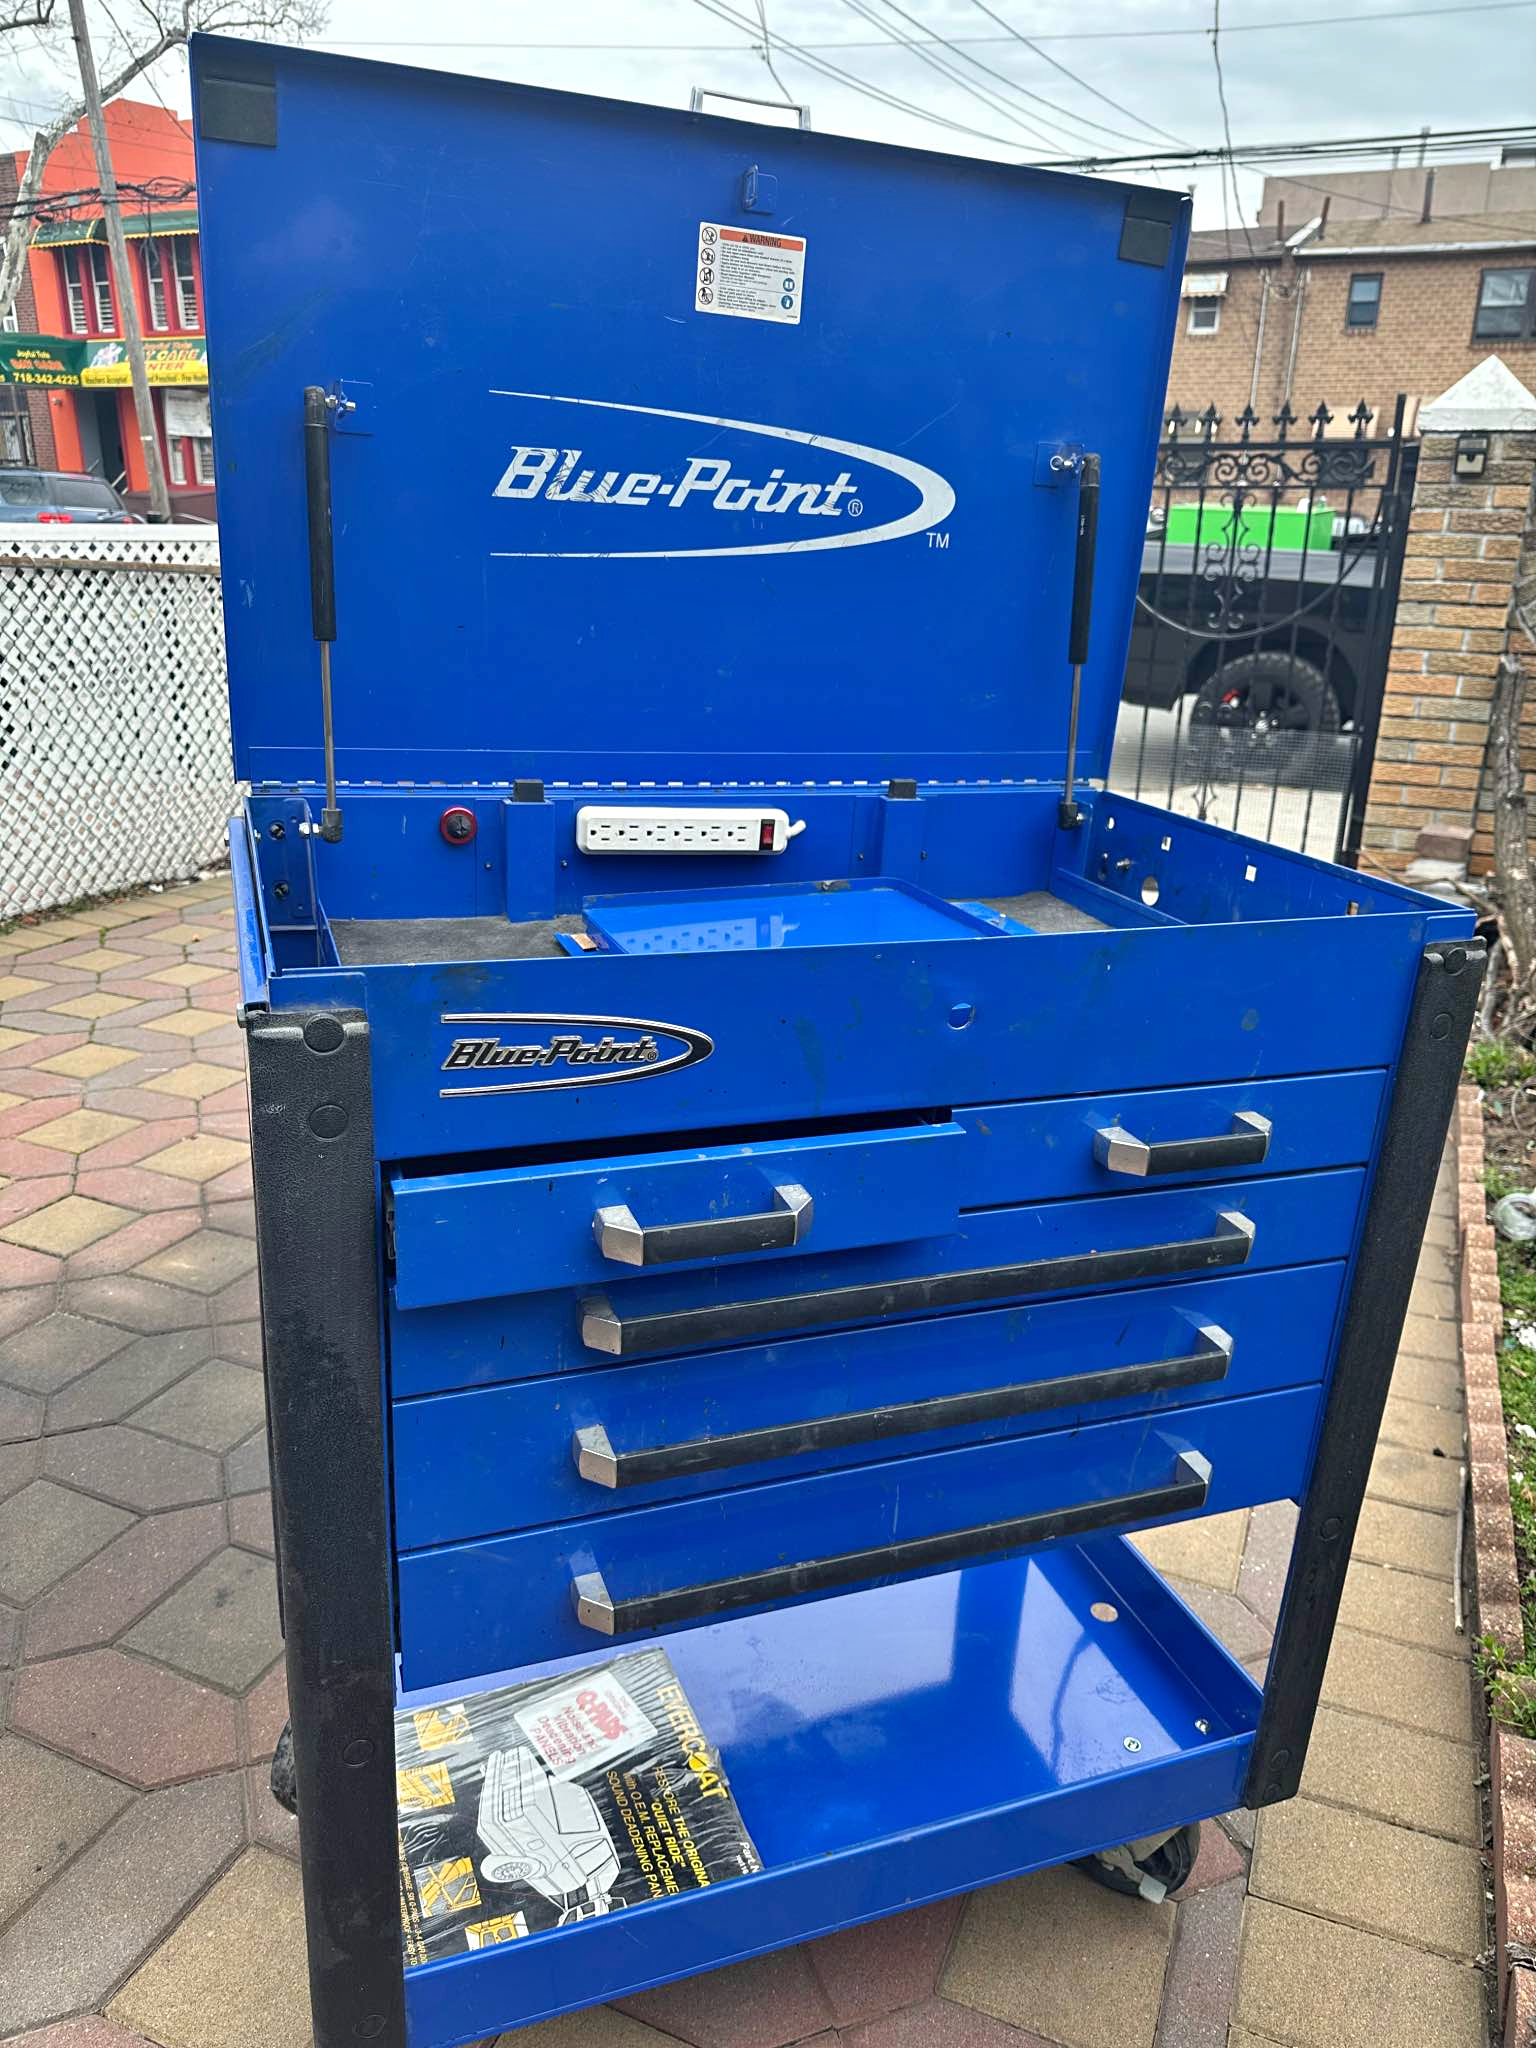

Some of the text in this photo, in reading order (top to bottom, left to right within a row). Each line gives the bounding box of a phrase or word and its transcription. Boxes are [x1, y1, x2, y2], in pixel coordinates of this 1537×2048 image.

[749, 233, 782, 248] WARNING
[926, 532, 950, 549] TM
[530, 1727, 561, 1766] PANELS
[656, 1685, 728, 1800] EVERCOAT
[607, 1770, 665, 1898] SOUND DEADENING PAN
[673, 1817, 690, 1840] THE
[664, 1834, 686, 1868] RIDE"
[740, 1842, 756, 1866] Part
